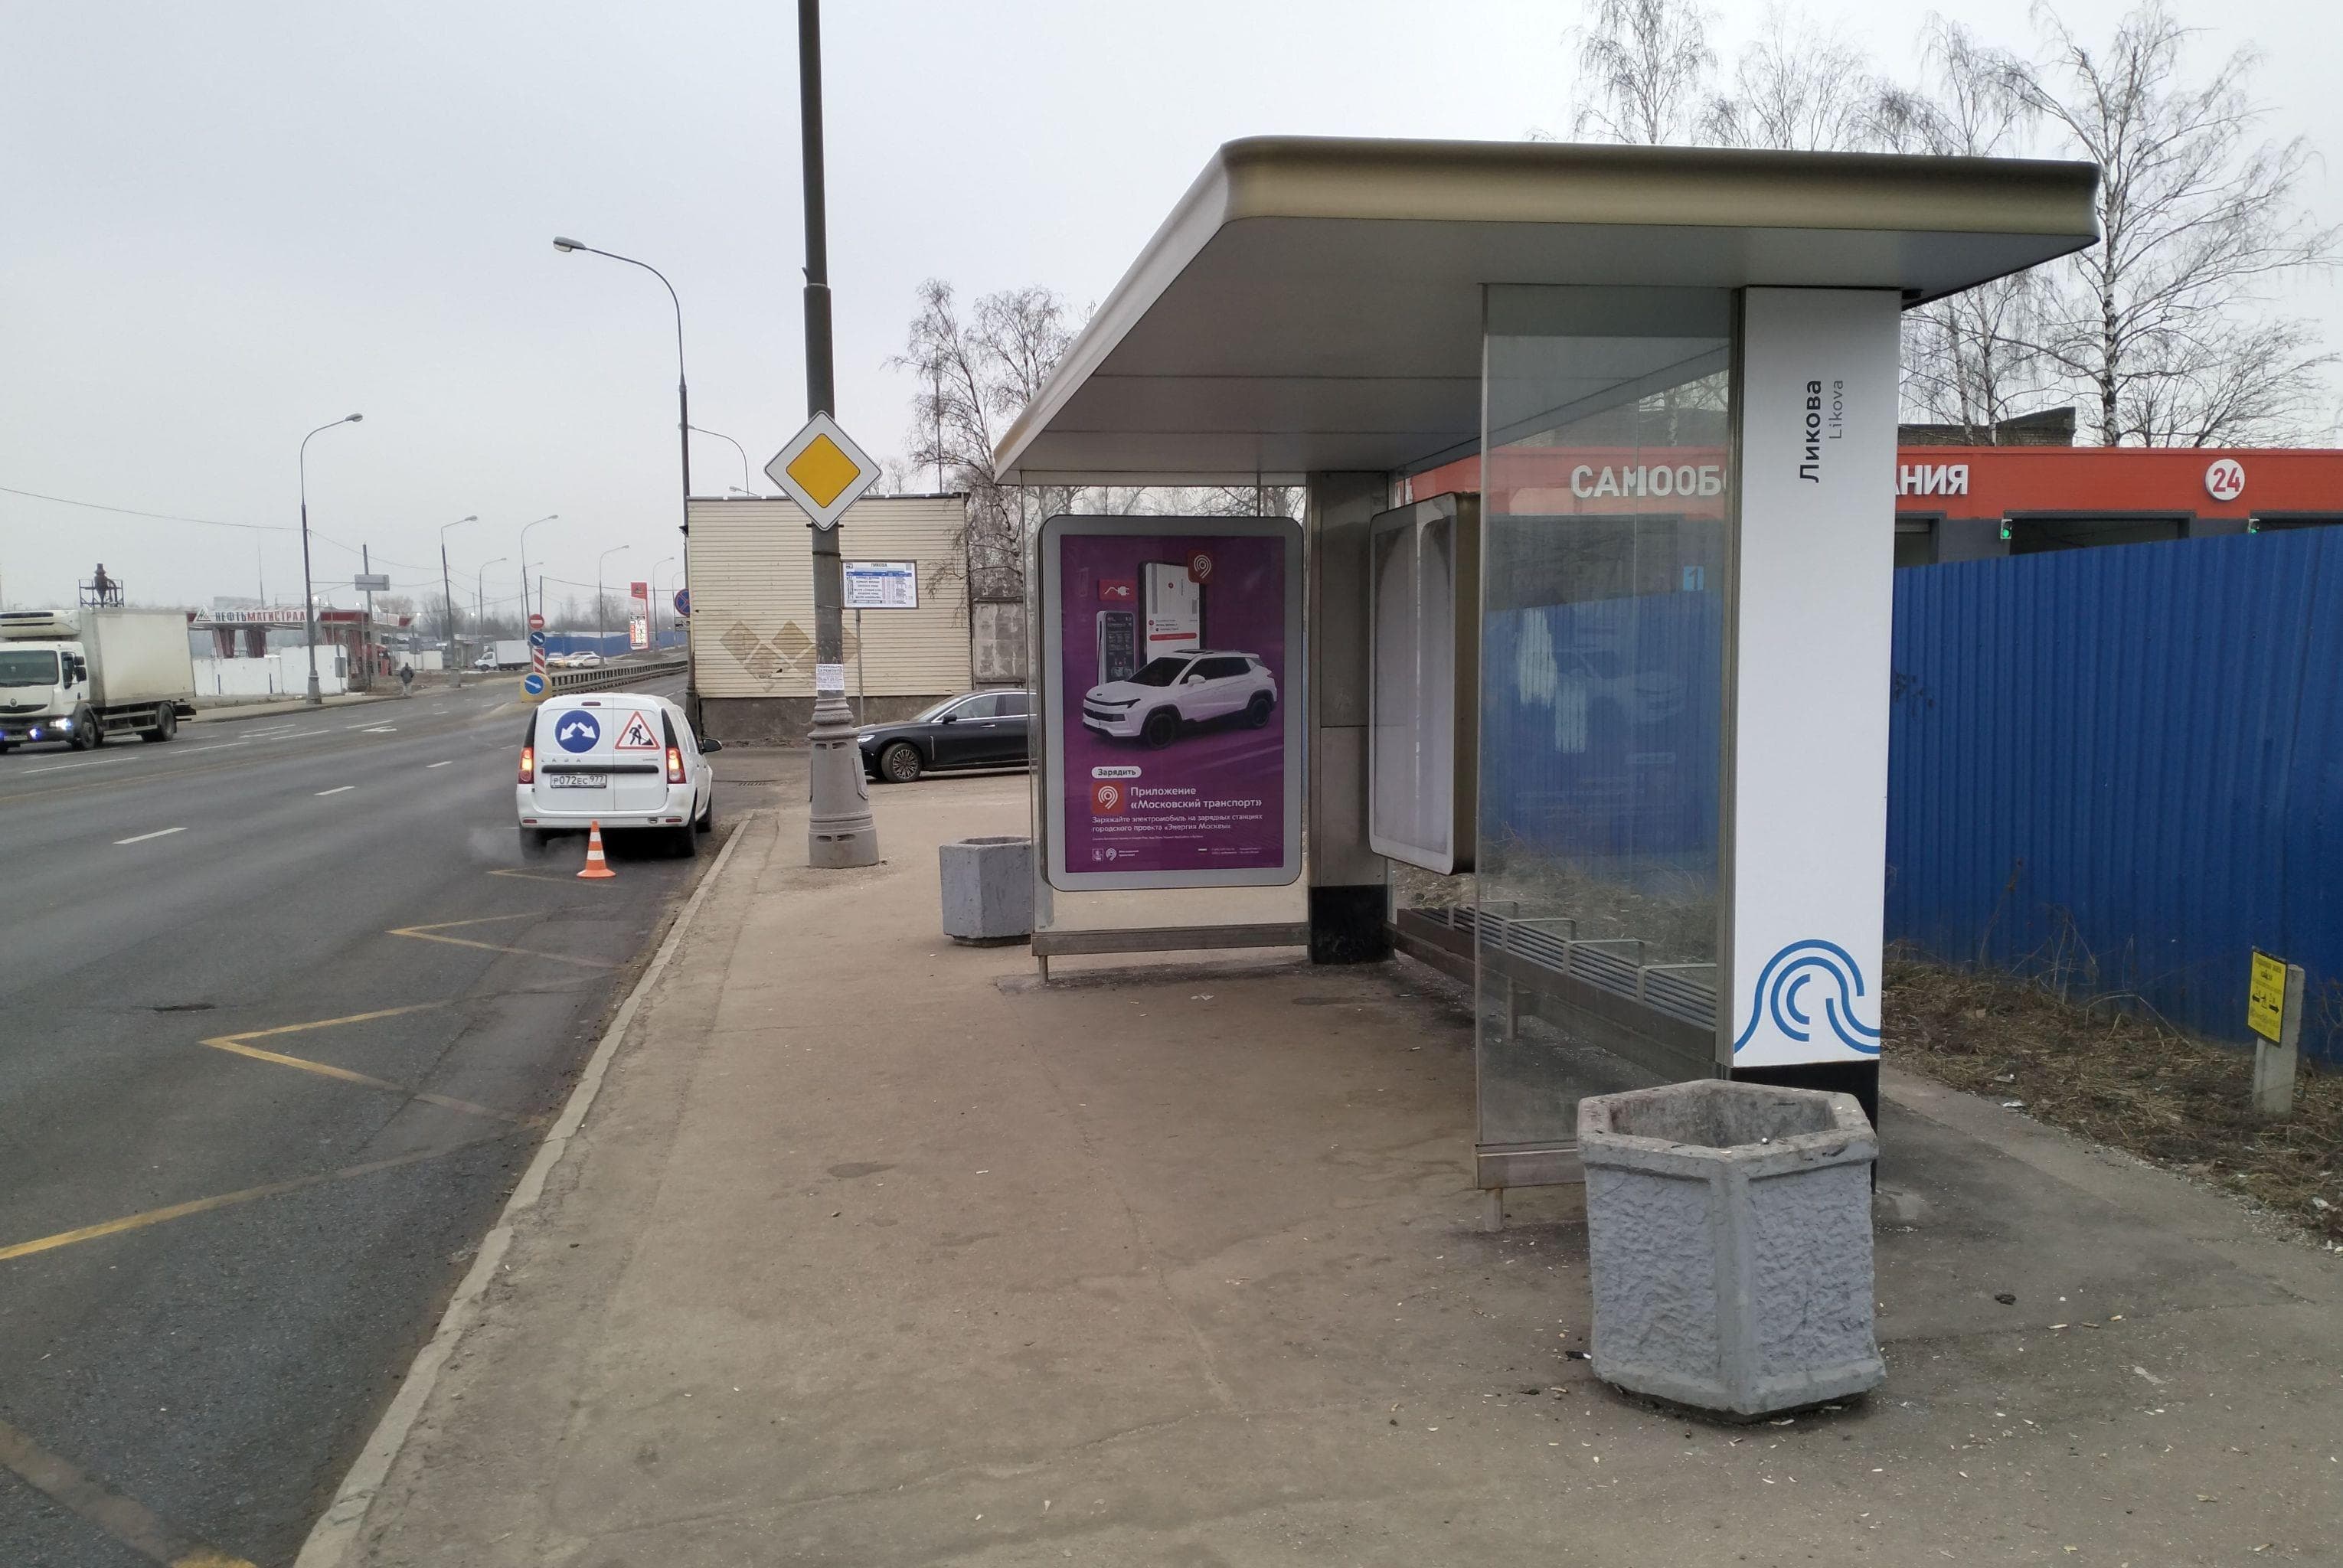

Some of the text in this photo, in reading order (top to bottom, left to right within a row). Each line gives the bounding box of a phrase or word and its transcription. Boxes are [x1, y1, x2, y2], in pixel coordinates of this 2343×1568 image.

[1828, 380, 1844, 439] Likova
[1799, 381, 1822, 484] Ликова
[1571, 464, 1969, 498] САМООБ НИЯ
[2213, 467, 2241, 492] 24
[215, 611, 306, 622] НЕФТЬМАГИСТРАЛ
[1097, 768, 1136, 777] Зарядить
[1130, 786, 1197, 798] Приложение
[1130, 799, 1263, 810] «Московский транспорт»
[1092, 815, 1131, 825] Заряжайте
[1132, 814, 1186, 824] электромобиль
[1198, 815, 1230, 823] зарядных
[1092, 825, 1132, 834] городского
[1164, 823, 1197, 831] «Энергия
